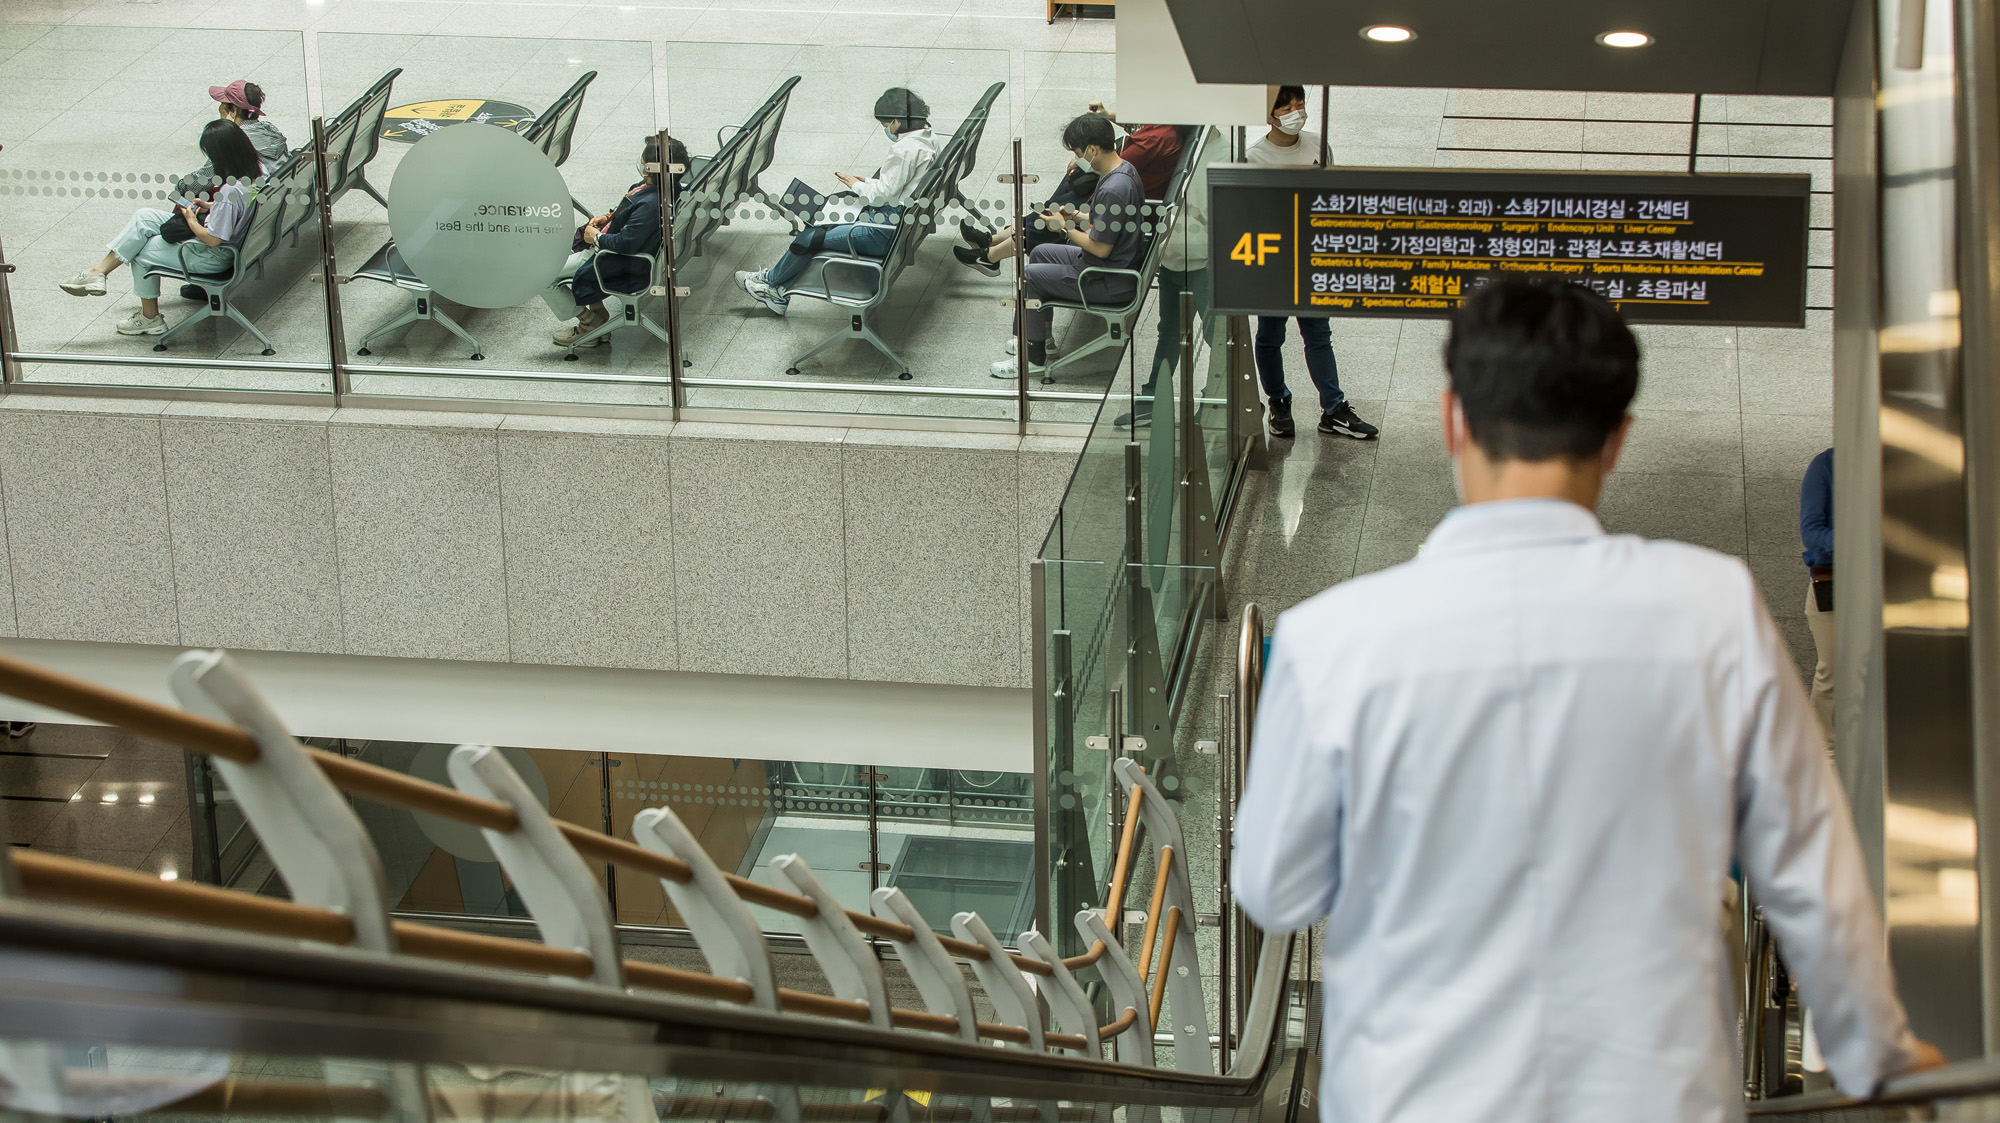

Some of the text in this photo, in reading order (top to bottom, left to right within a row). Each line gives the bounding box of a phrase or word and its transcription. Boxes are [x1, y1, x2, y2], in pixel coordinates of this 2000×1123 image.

[1503, 198, 1626, 219] 소화기내시경실
[1637, 200, 1690, 221] 간센터
[1310, 218, 1678, 235] Gastroenterology Center (Gastroenterology Surgery) Endoscopy Unit Liver Center
[1230, 232, 1282, 266] 4F
[1310, 233, 1723, 260] 산부인과 가정의학과 정형외과 관절스포츠재활센터
[1310, 258, 1764, 276] Obstetrics & Gynecology Family Medicine Orthopedic Surgery Sports Medicine & Rehabilitation Center
[1311, 272, 1396, 293] 영상의학과
[1410, 274, 1462, 295] 채혈실
[1635, 279, 1707, 300] 초음파실
[1310, 296, 1354, 308] Radiology
[1362, 297, 1404, 308] Specimen
[1405, 298, 1448, 309] Collection
